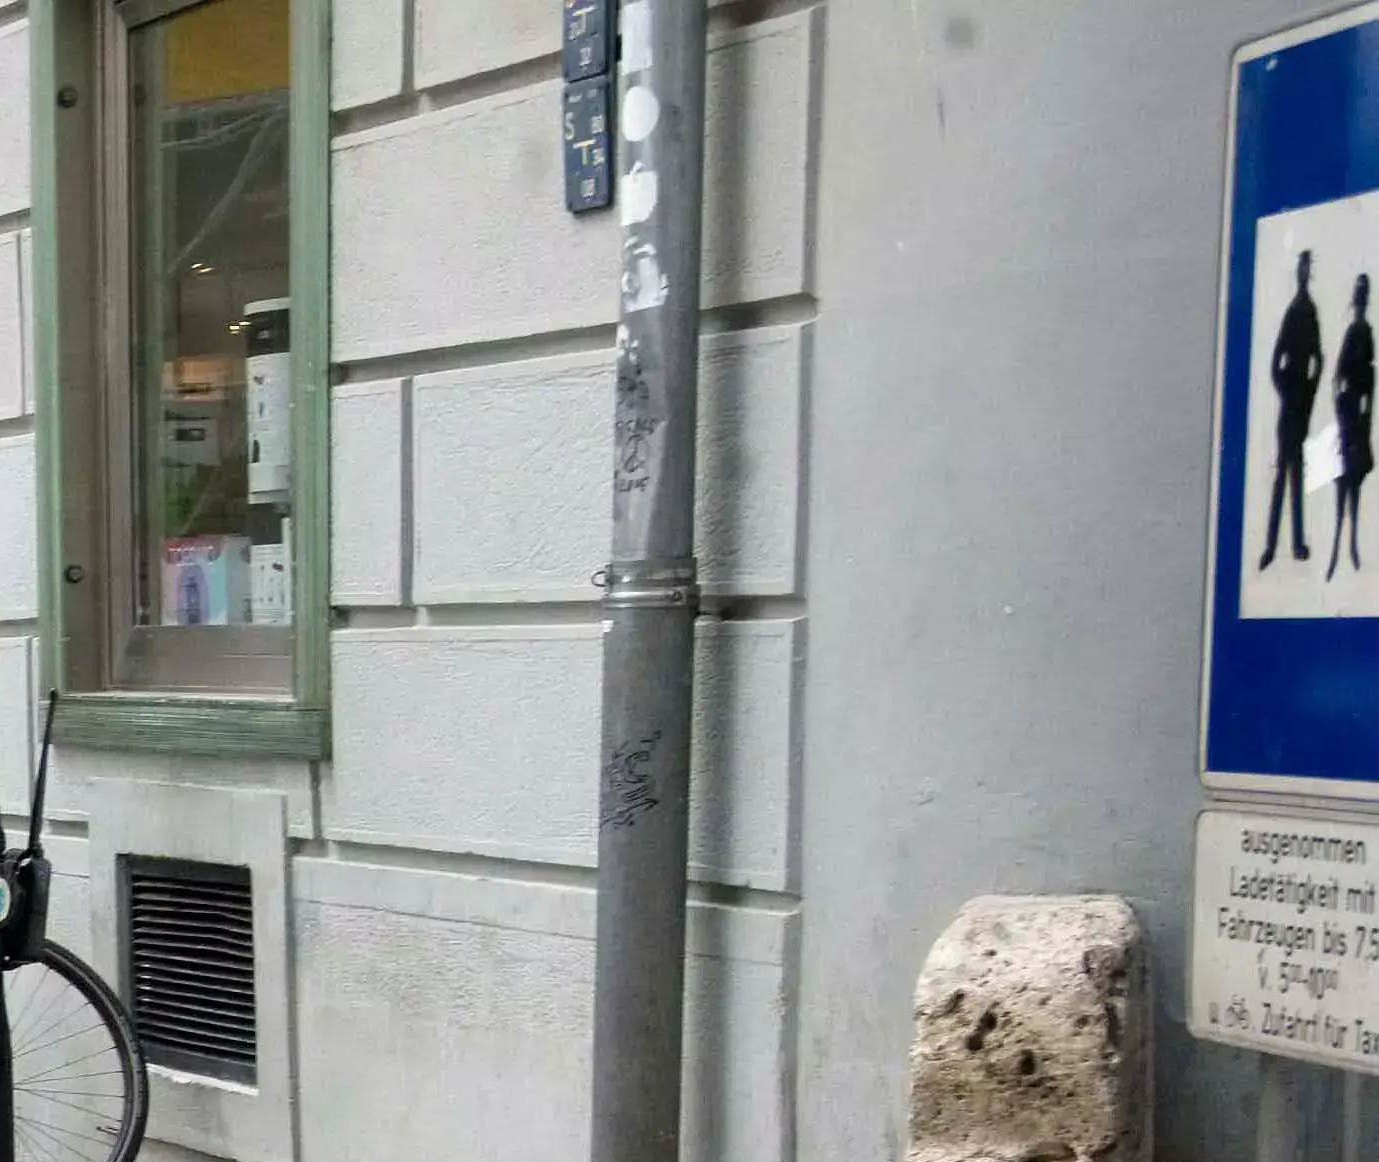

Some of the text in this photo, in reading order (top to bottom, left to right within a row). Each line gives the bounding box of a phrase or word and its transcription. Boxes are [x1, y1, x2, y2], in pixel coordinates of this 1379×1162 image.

[1241, 829, 1366, 865] ausgenommen
[1229, 865, 1376, 914] Ladetätigkeit mit
[1217, 906, 1316, 957] Fahrzeugen
[1323, 920, 1349, 957] bis
[1261, 1002, 1323, 1043] Zufahrt
[1324, 1014, 1347, 1050] für
